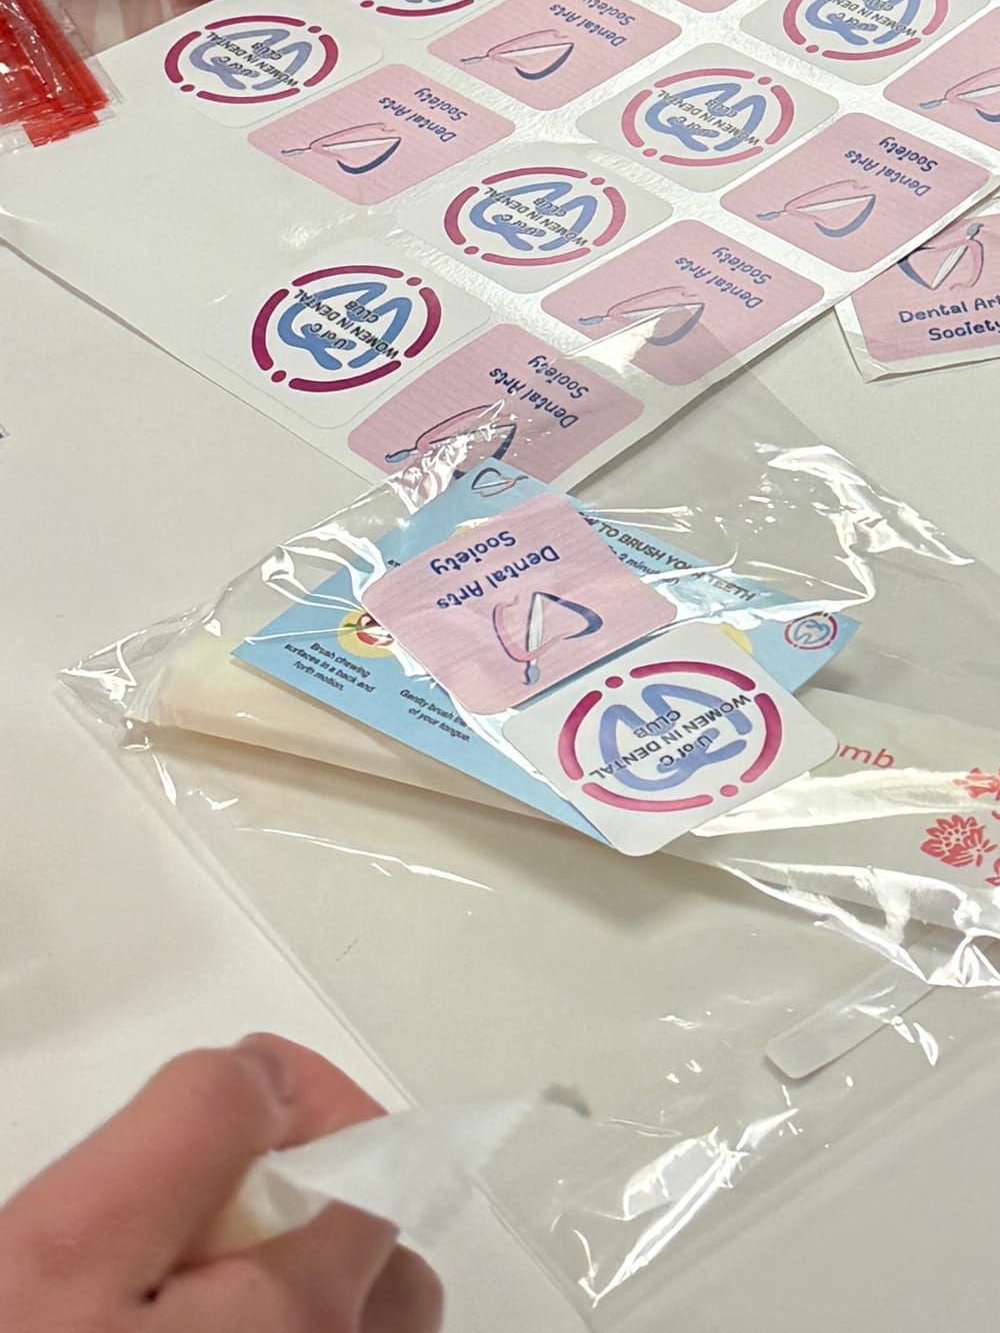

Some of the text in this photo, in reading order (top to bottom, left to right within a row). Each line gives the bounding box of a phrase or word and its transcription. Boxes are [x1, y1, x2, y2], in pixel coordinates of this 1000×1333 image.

[205, 31, 247, 56] DENTAL
[548, 3, 627, 47] Dental Arts
[254, 60, 298, 87] WOMEN
[378, 96, 457, 142] Dental Arts
[413, 87, 468, 121] Society
[843, 149, 932, 197] Dental Arts
[878, 136, 938, 172] Society
[483, 186, 530, 213] DENTAL
[538, 217, 588, 246] WOMEN
[674, 256, 763, 308] Dental Arts
[711, 246, 772, 284] Society
[293, 288, 399, 359] WOMEN IN DENTAL
[343, 299, 379, 323] CLUB
[897, 300, 968, 323] Dental
[527, 354, 589, 399] Society
[488, 367, 578, 428] Dental Arts
[429, 530, 516, 575] Society
[598, 522, 619, 538] TO
[618, 533, 666, 560] BRUSH
[435, 545, 560, 609] Dental Arts
[589, 694, 751, 778] WOMEN IN DENTAL
[632, 709, 681, 738] CLUB
[839, 745, 894, 768] mb
